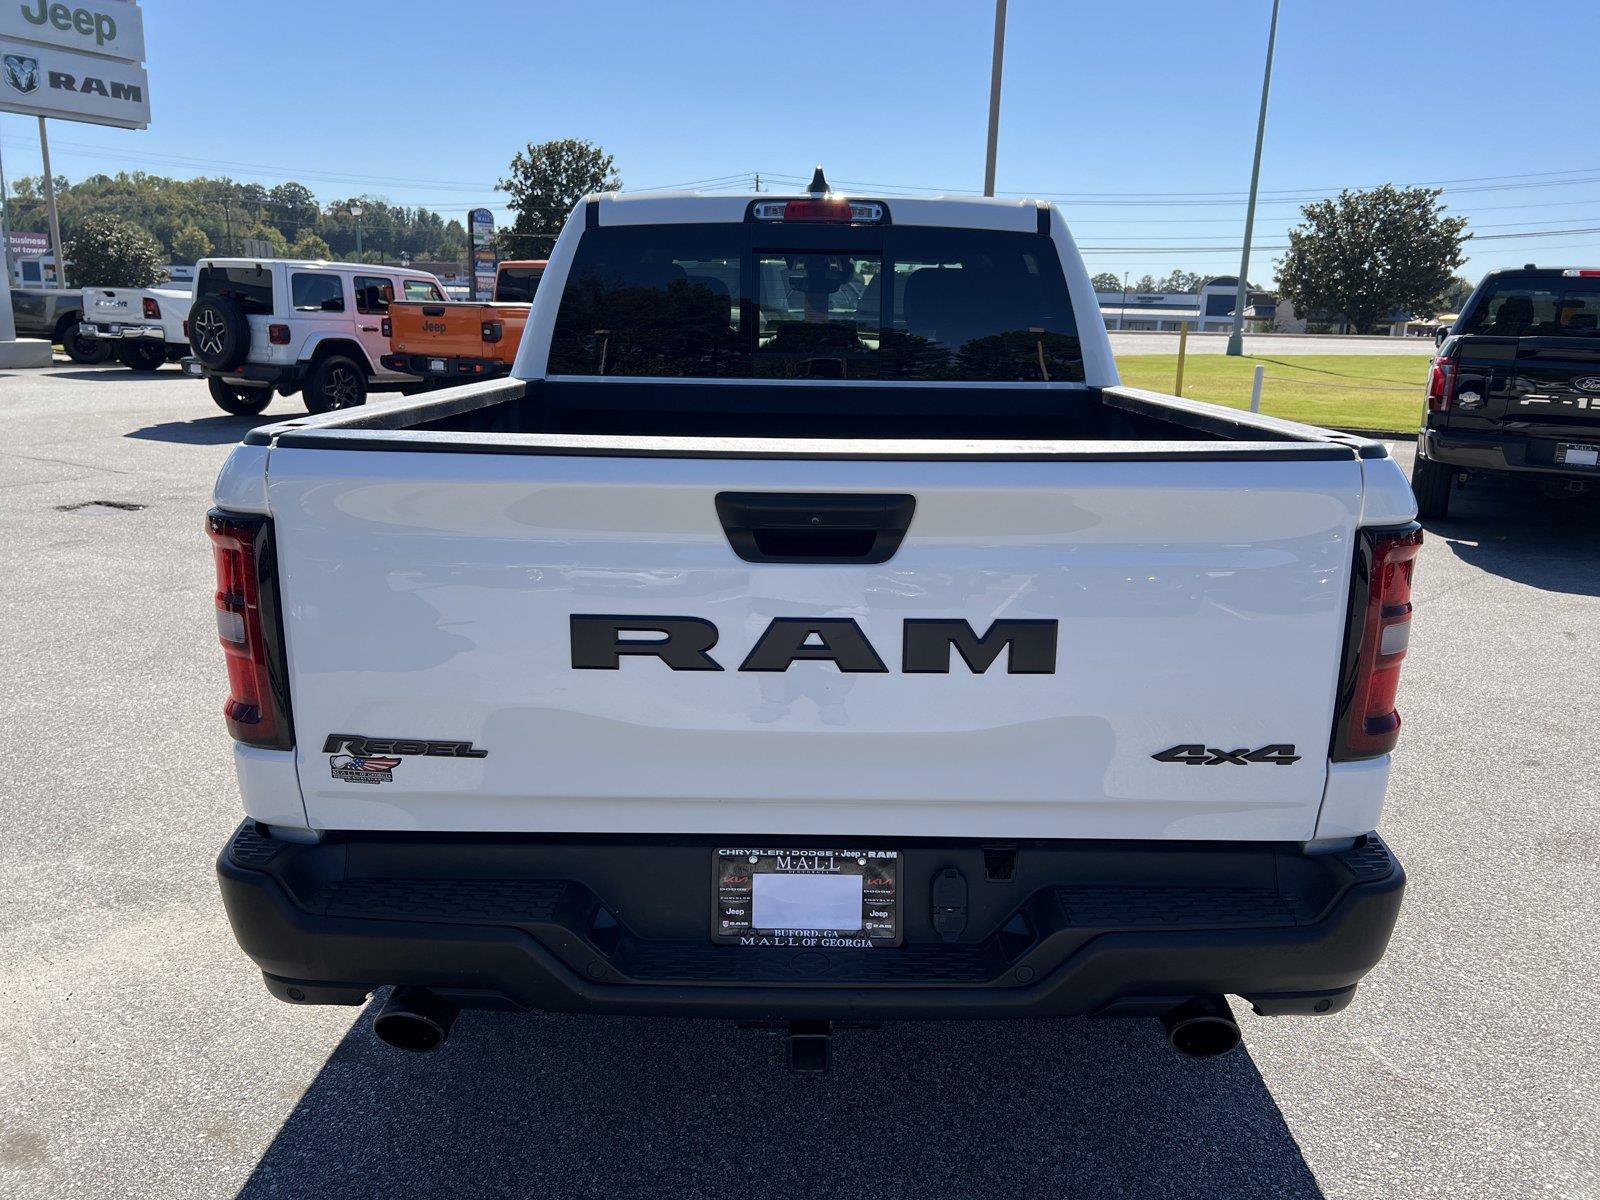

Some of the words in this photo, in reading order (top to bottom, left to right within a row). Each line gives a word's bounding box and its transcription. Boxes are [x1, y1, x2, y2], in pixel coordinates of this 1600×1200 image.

[20, 0, 117, 46] Jeep
[48, 70, 142, 103] RAM
[10, 236, 46, 245] business
[422, 320, 446, 334] Jeep
[1583, 379, 1600, 389] For
[1520, 394, 1600, 410] F-15
[570, 613, 1059, 674] RAM
[322, 733, 488, 758] REBEL
[1150, 744, 1302, 765] 4x4
[840, 850, 861, 859] Jeep
[868, 851, 898, 859] RAM
[725, 907, 745, 916] Jeep
[869, 909, 888, 918] Jeep
[823, 930, 839, 938] GA
[802, 938, 817, 947] OF
[821, 938, 874, 948] GEORGIA
